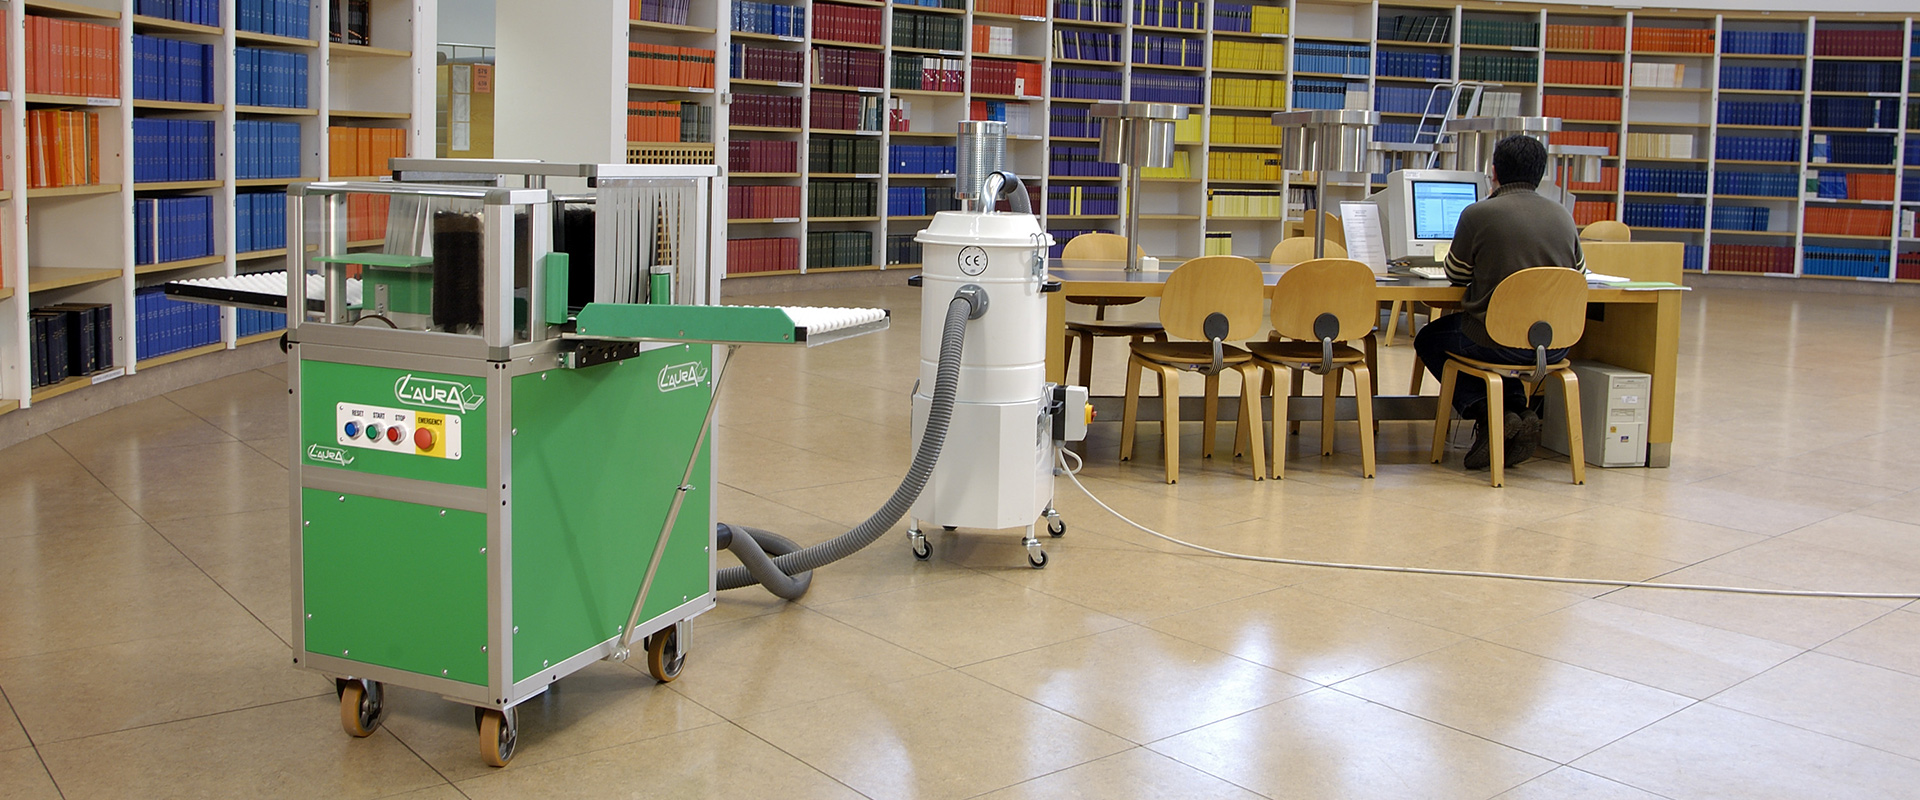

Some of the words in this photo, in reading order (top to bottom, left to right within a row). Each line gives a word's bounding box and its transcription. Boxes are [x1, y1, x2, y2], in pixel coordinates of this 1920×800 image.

[351, 409, 364, 417] RESET
[372, 411, 386, 420] START
[394, 414, 406, 422] STOP
[417, 416, 443, 426] EMERGENCY
